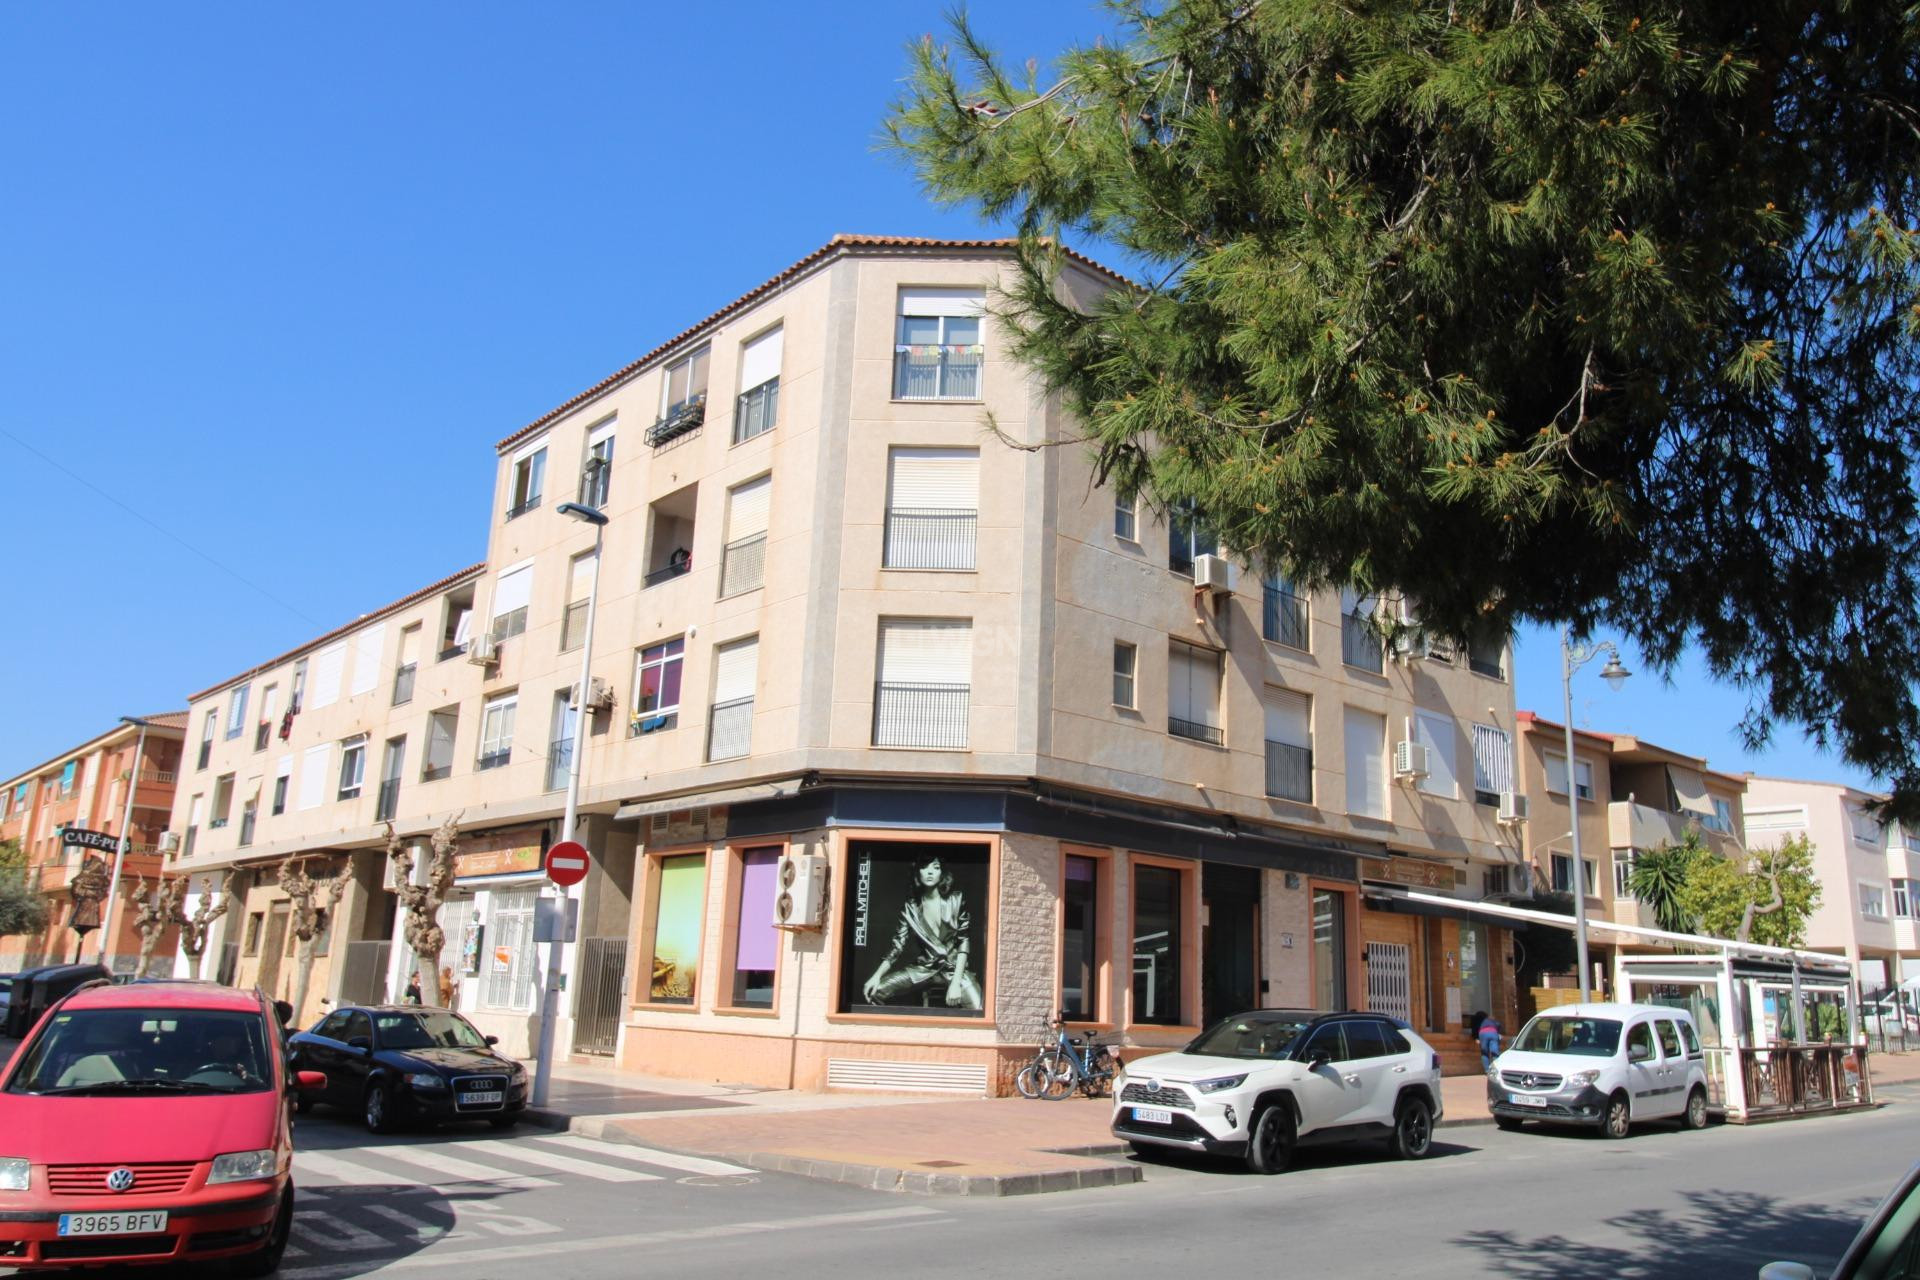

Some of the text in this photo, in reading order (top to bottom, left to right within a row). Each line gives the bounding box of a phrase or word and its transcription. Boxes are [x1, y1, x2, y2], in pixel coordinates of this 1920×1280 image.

[855, 911, 867, 946] PAUL
[73, 1214, 163, 1232] 3965 BFV
